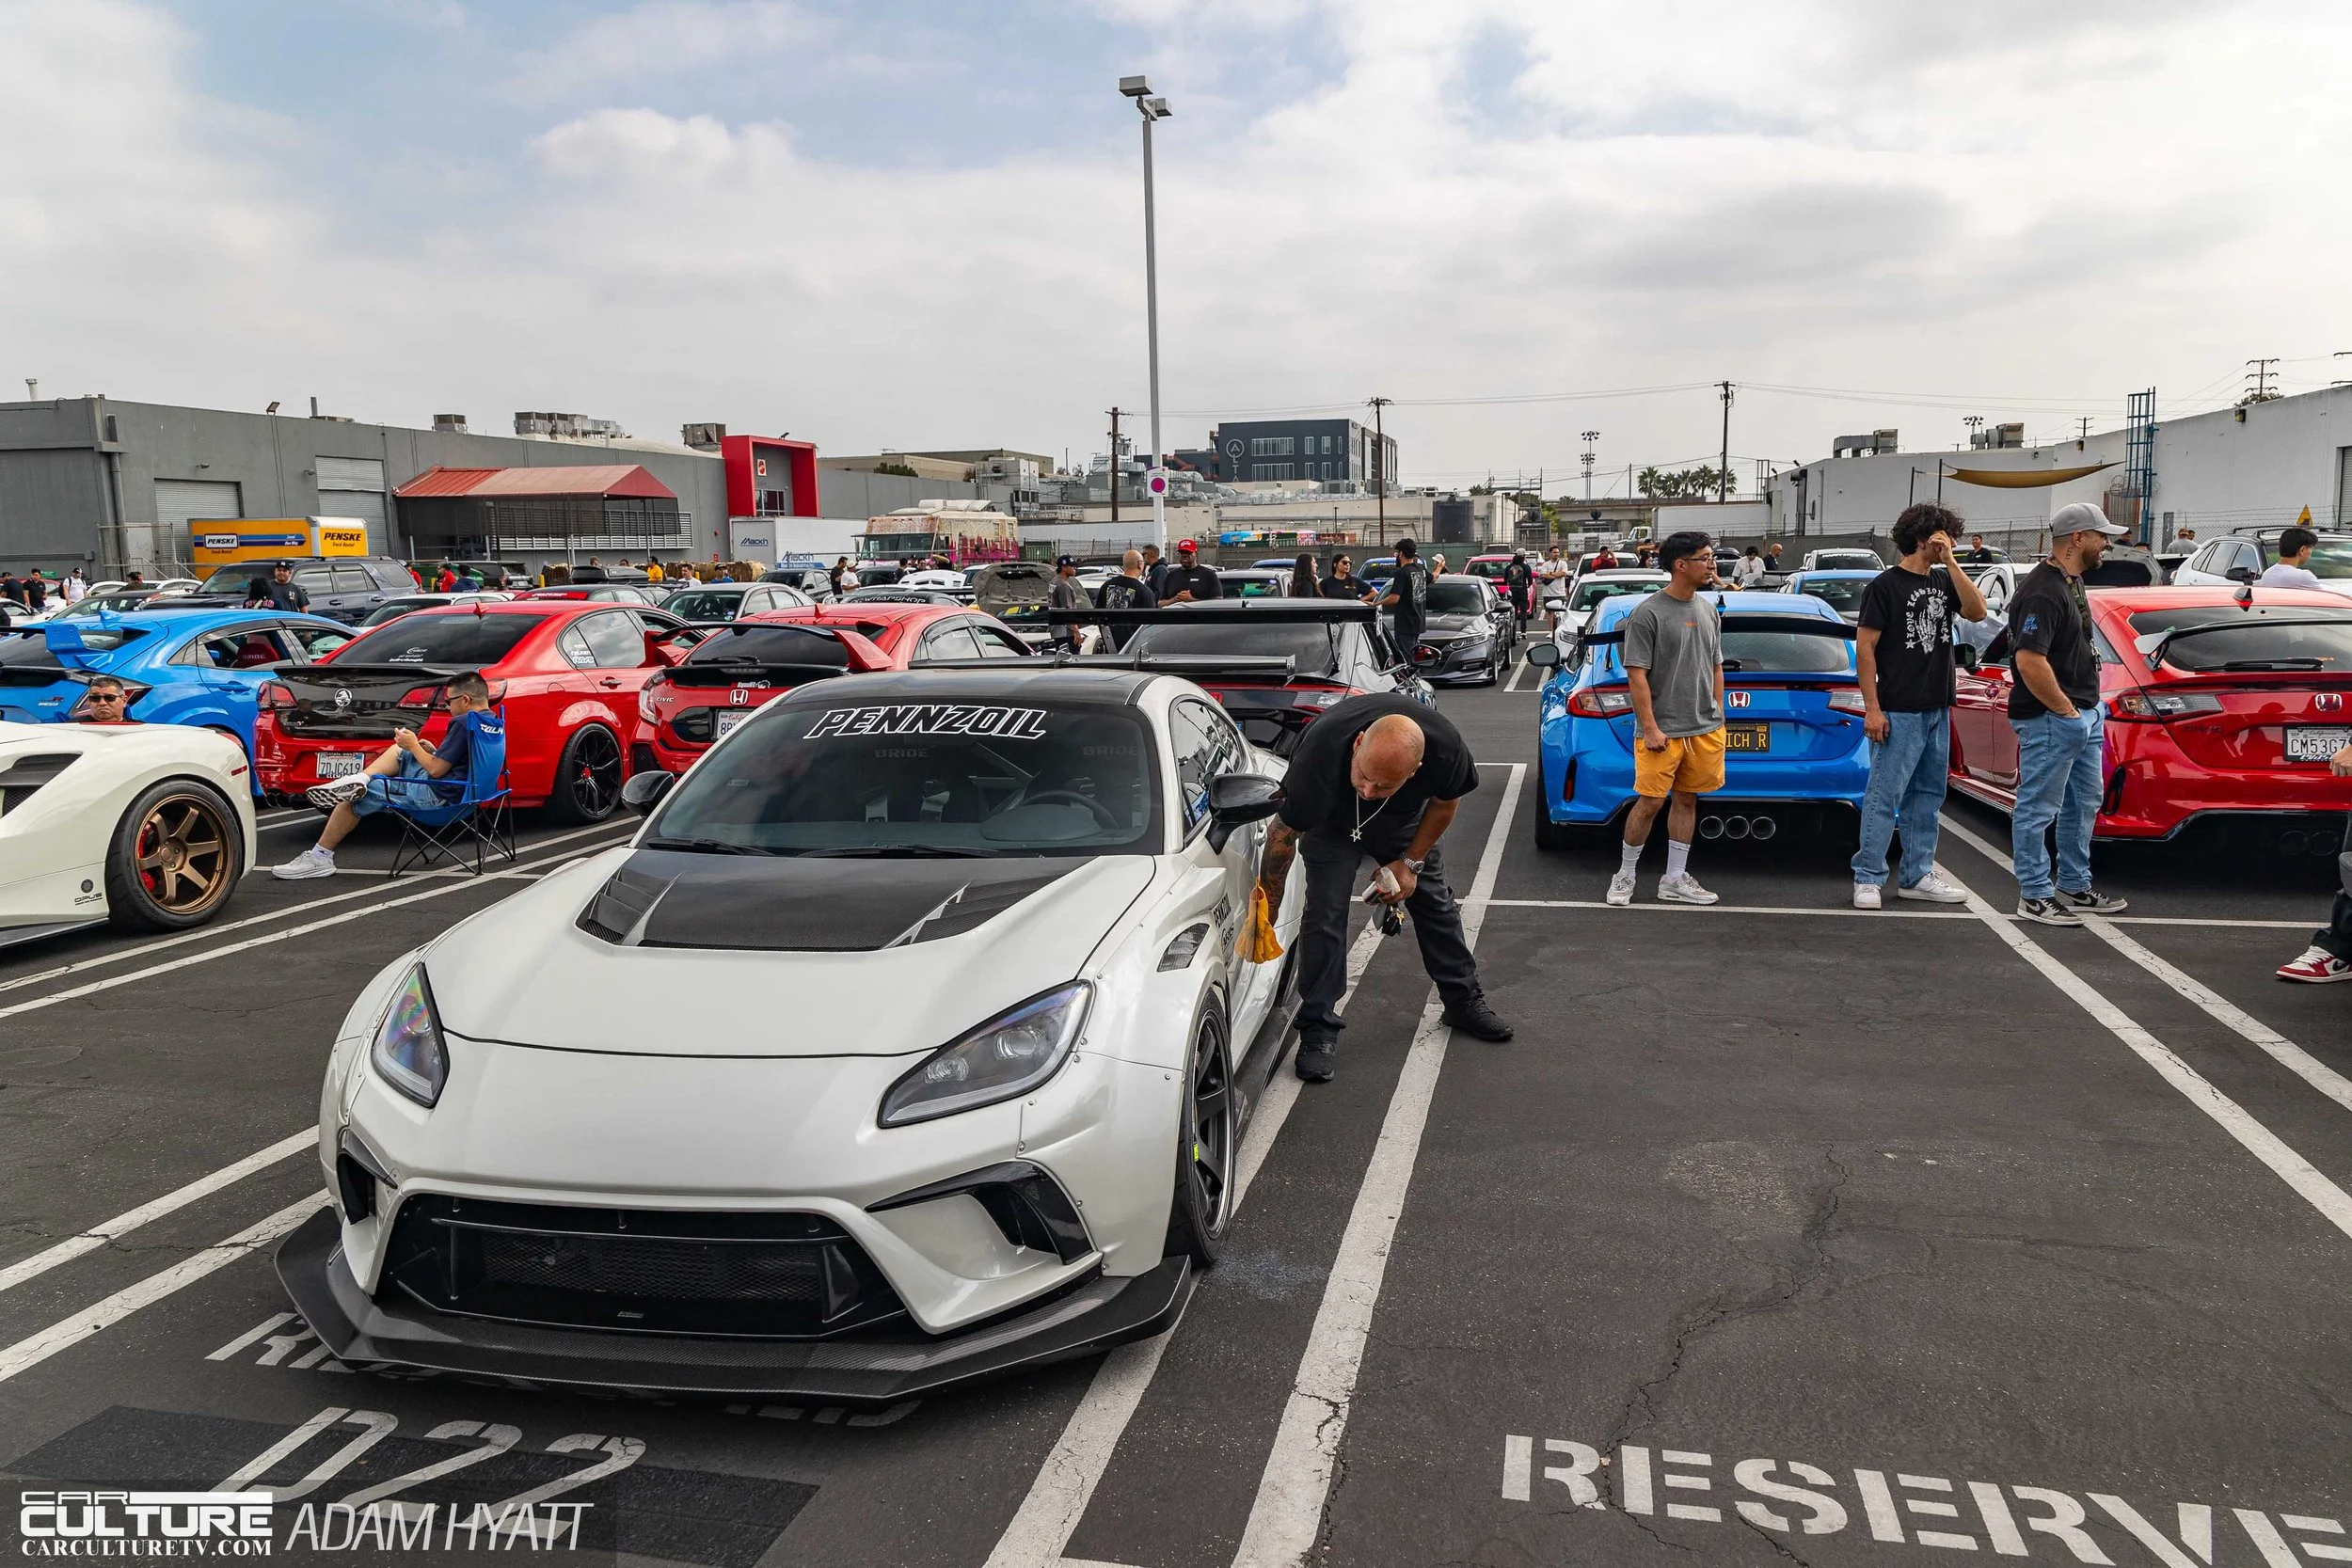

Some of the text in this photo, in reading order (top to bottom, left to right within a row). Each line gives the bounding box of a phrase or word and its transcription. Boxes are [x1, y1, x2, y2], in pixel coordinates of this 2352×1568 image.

[324, 532, 361, 542] PENSKE
[803, 705, 1046, 739] PENNZOIL
[1758, 733, 1767, 748] R
[321, 762, 361, 775] 7DJC619
[209, 1406, 646, 1541] D22
